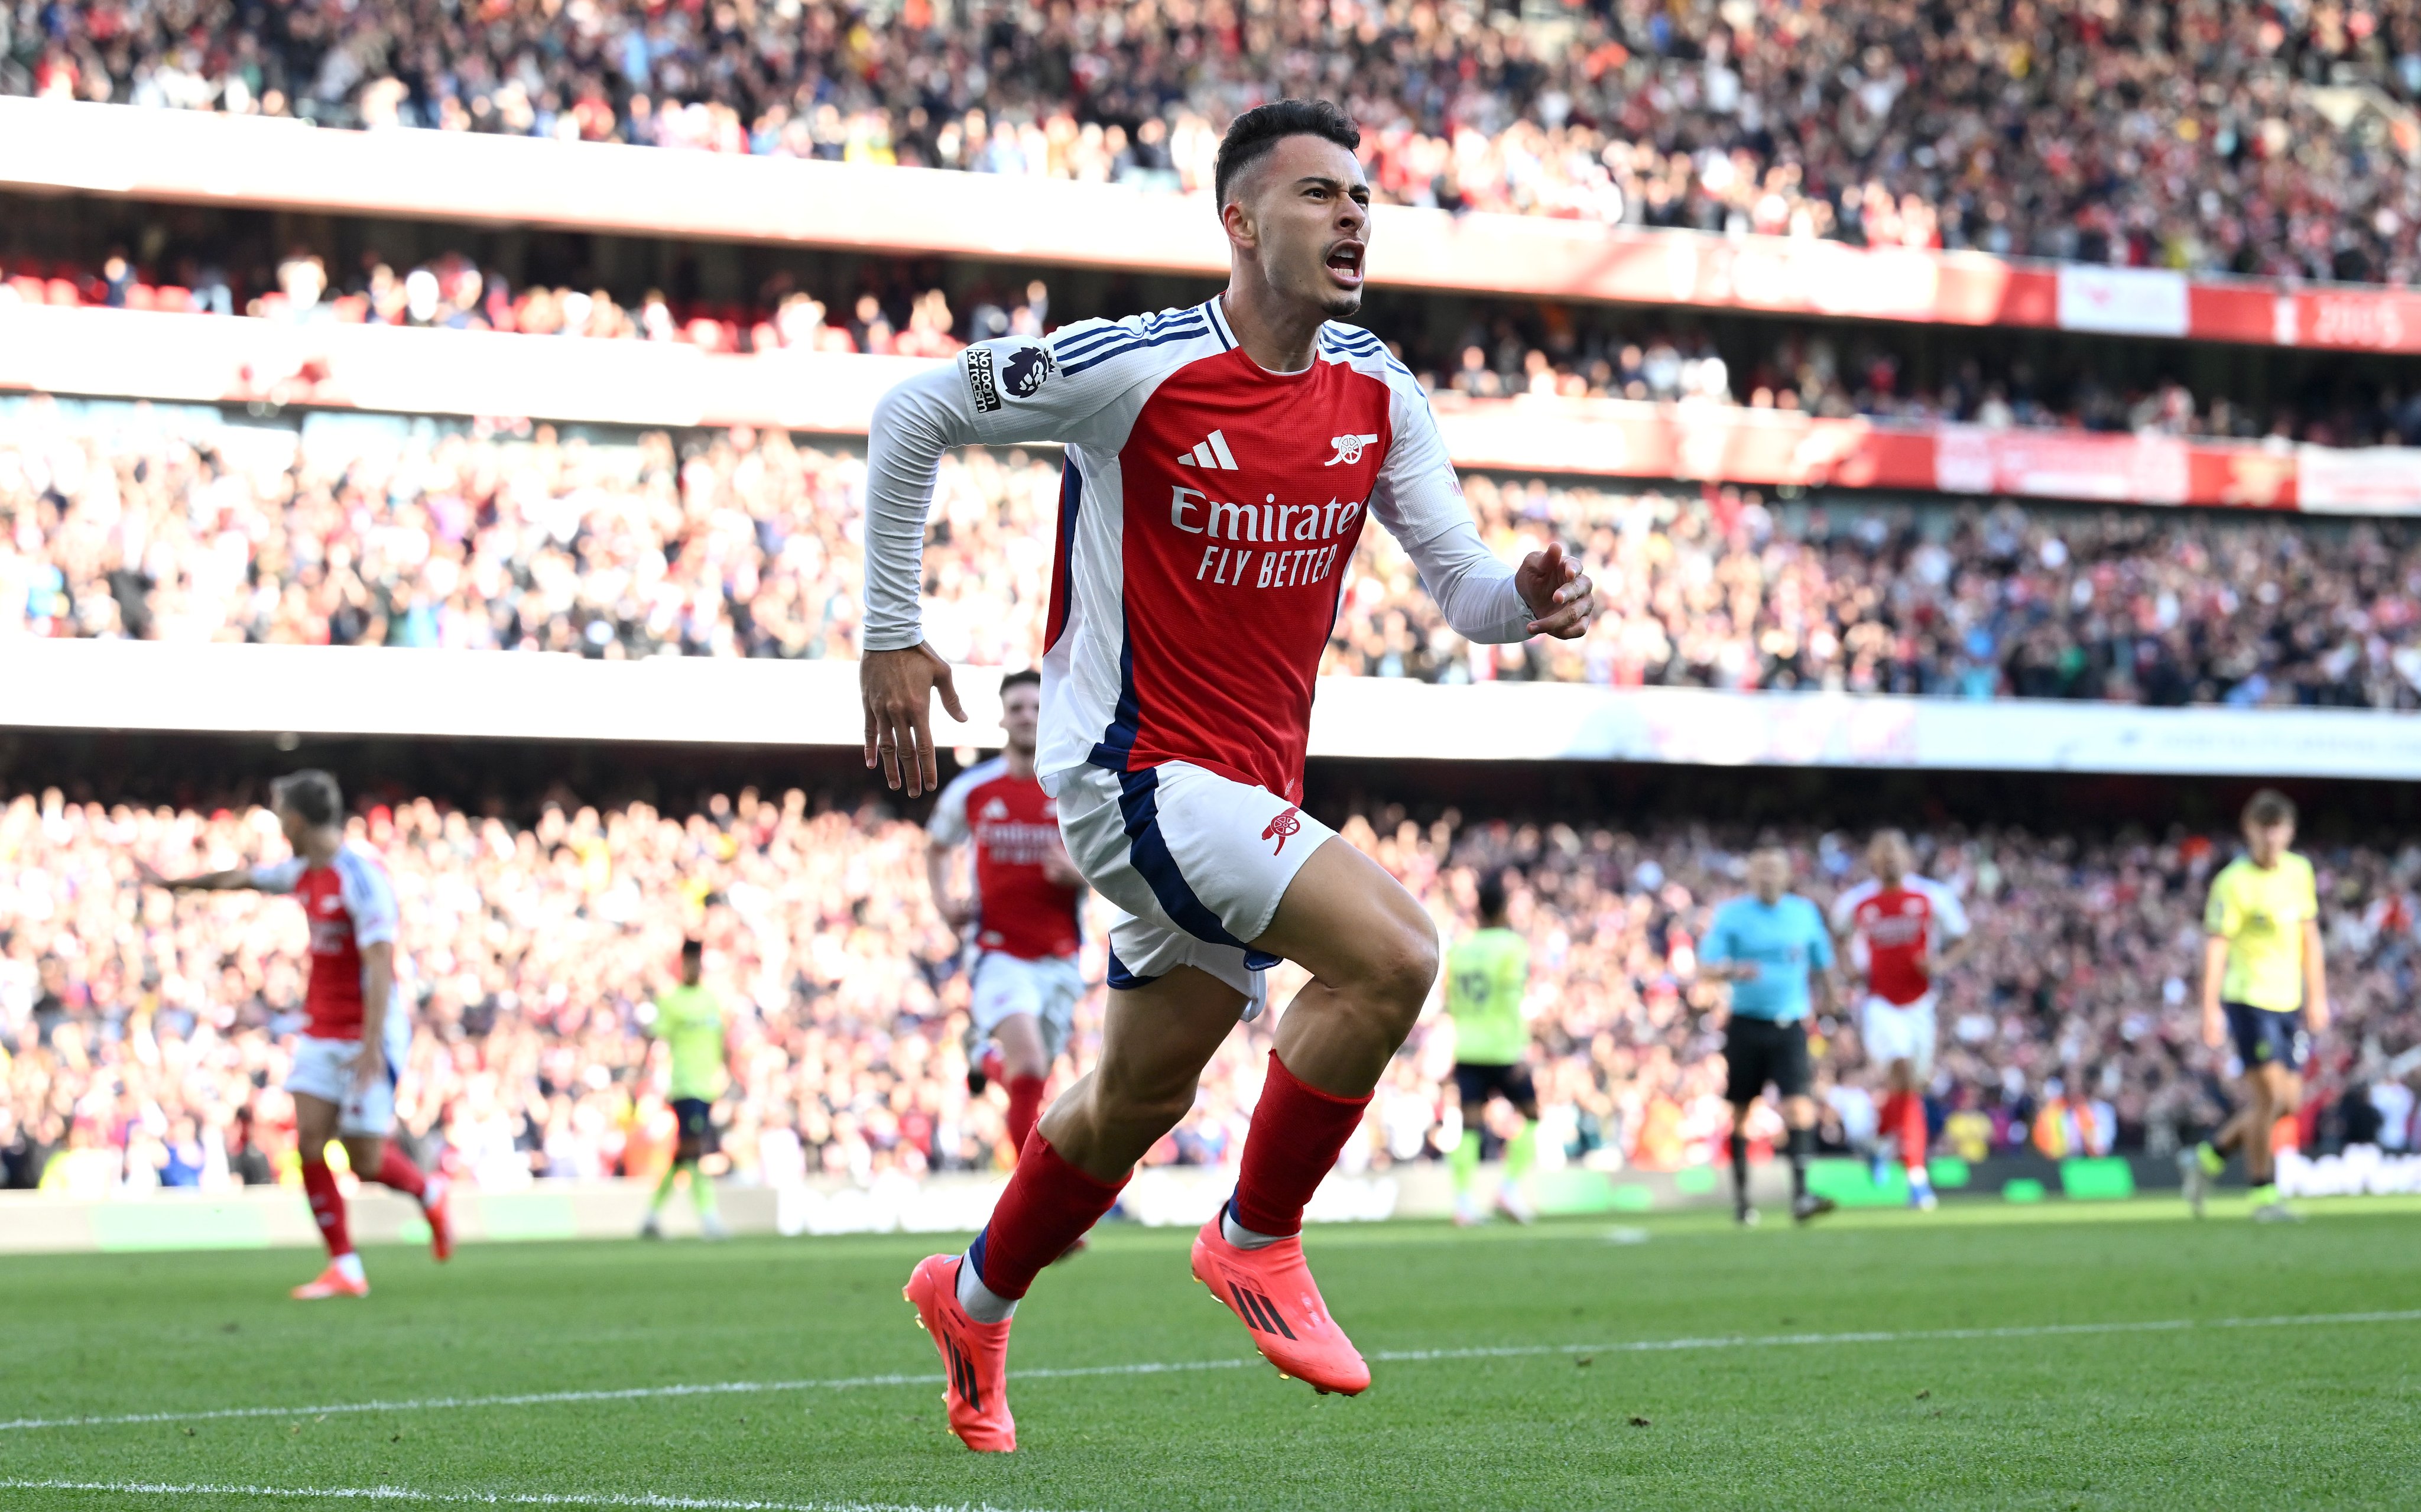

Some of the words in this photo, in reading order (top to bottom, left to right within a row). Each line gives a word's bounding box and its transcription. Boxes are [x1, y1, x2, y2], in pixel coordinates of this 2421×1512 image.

[967, 349, 979, 368] for
[978, 349, 991, 368] No
[969, 369, 988, 413] racism
[981, 369, 997, 405] room
[1171, 485, 1367, 542] Emirate
[1196, 545, 1252, 586] FLY
[1257, 543, 1338, 589] BETTER
